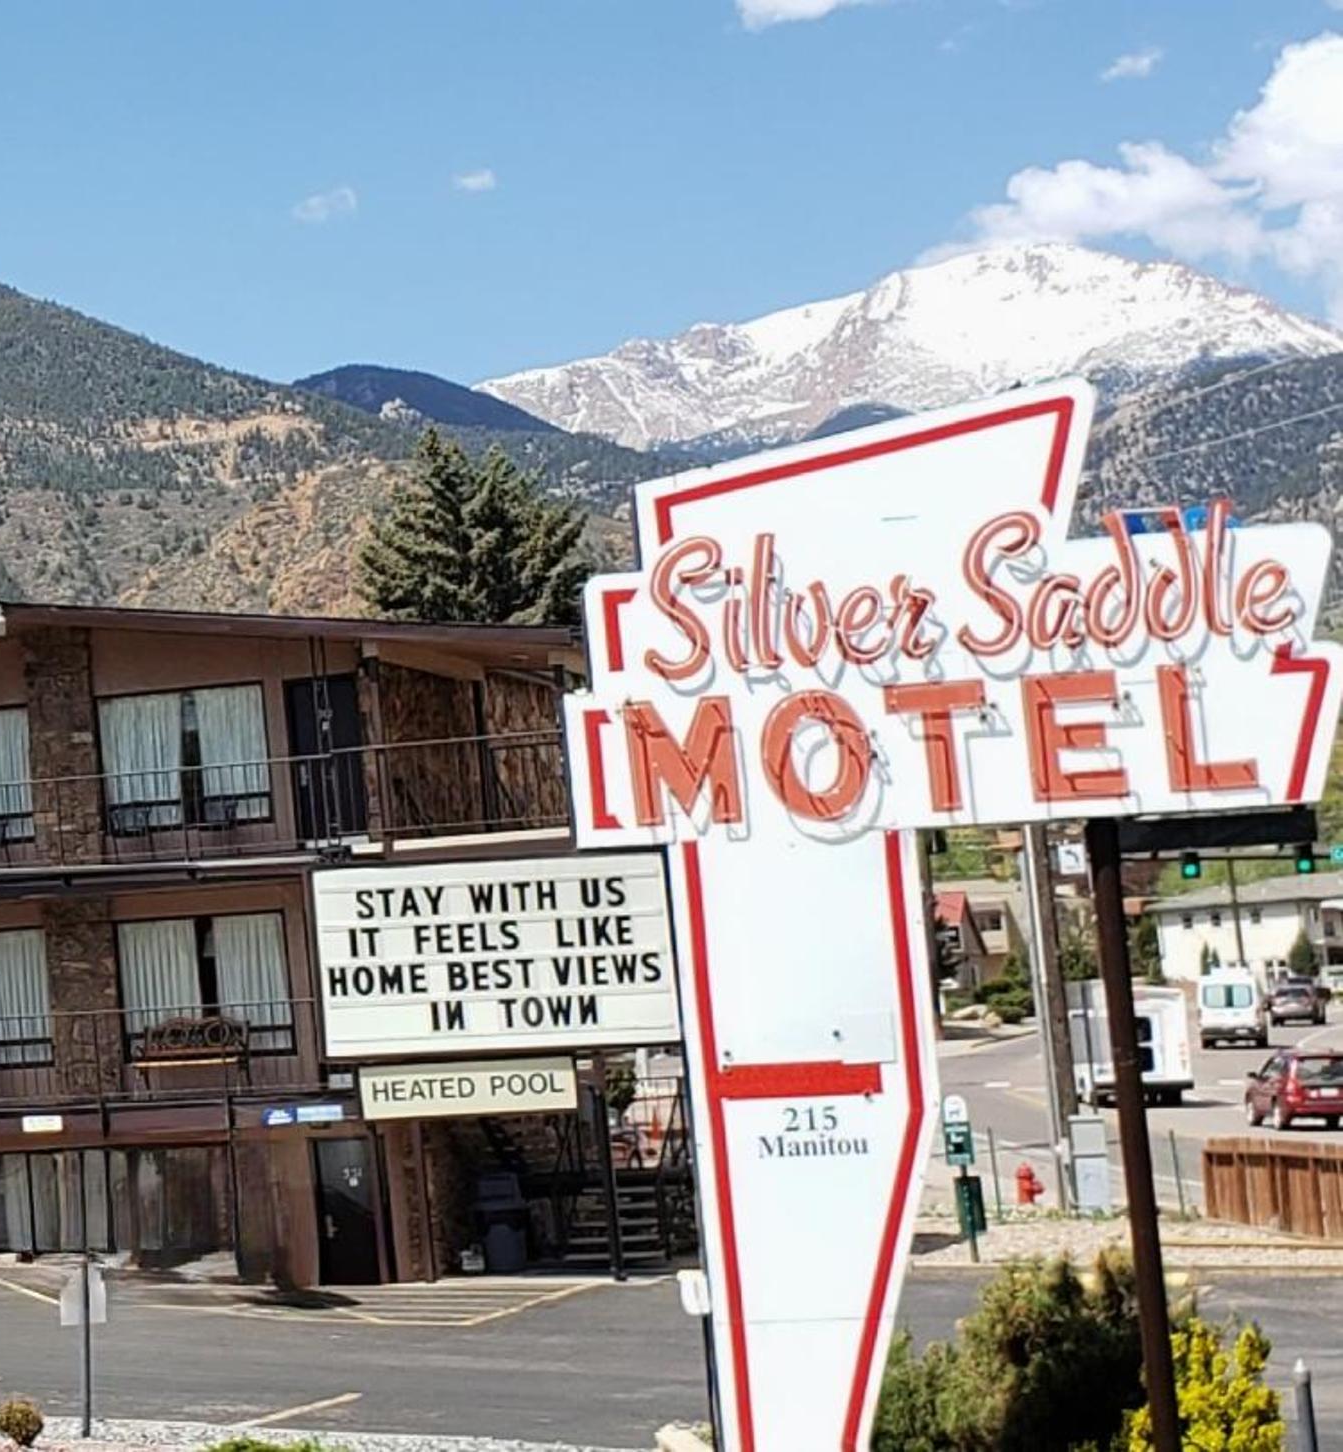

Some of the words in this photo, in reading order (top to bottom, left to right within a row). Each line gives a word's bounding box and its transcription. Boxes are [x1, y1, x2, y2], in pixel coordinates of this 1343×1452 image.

[645, 533, 937, 681] Silver
[957, 500, 1294, 656] Saddle
[621, 664, 1259, 826] MOTEL
[356, 886, 444, 920] STAY
[469, 880, 557, 913] WITH
[580, 877, 626, 908] US
[348, 927, 381, 957] IT
[413, 920, 520, 954] FEELS
[556, 915, 634, 948] LIKE
[329, 963, 428, 996] HOME
[447, 958, 534, 991] BEST
[553, 952, 662, 986] VIEWS
[430, 1000, 466, 1031] IN
[498, 994, 599, 1028] TOWN
[371, 1077, 476, 1102] HEATED
[490, 1072, 565, 1097] POOL
[783, 1105, 838, 1132] 215
[759, 1133, 868, 1158] Manitou
